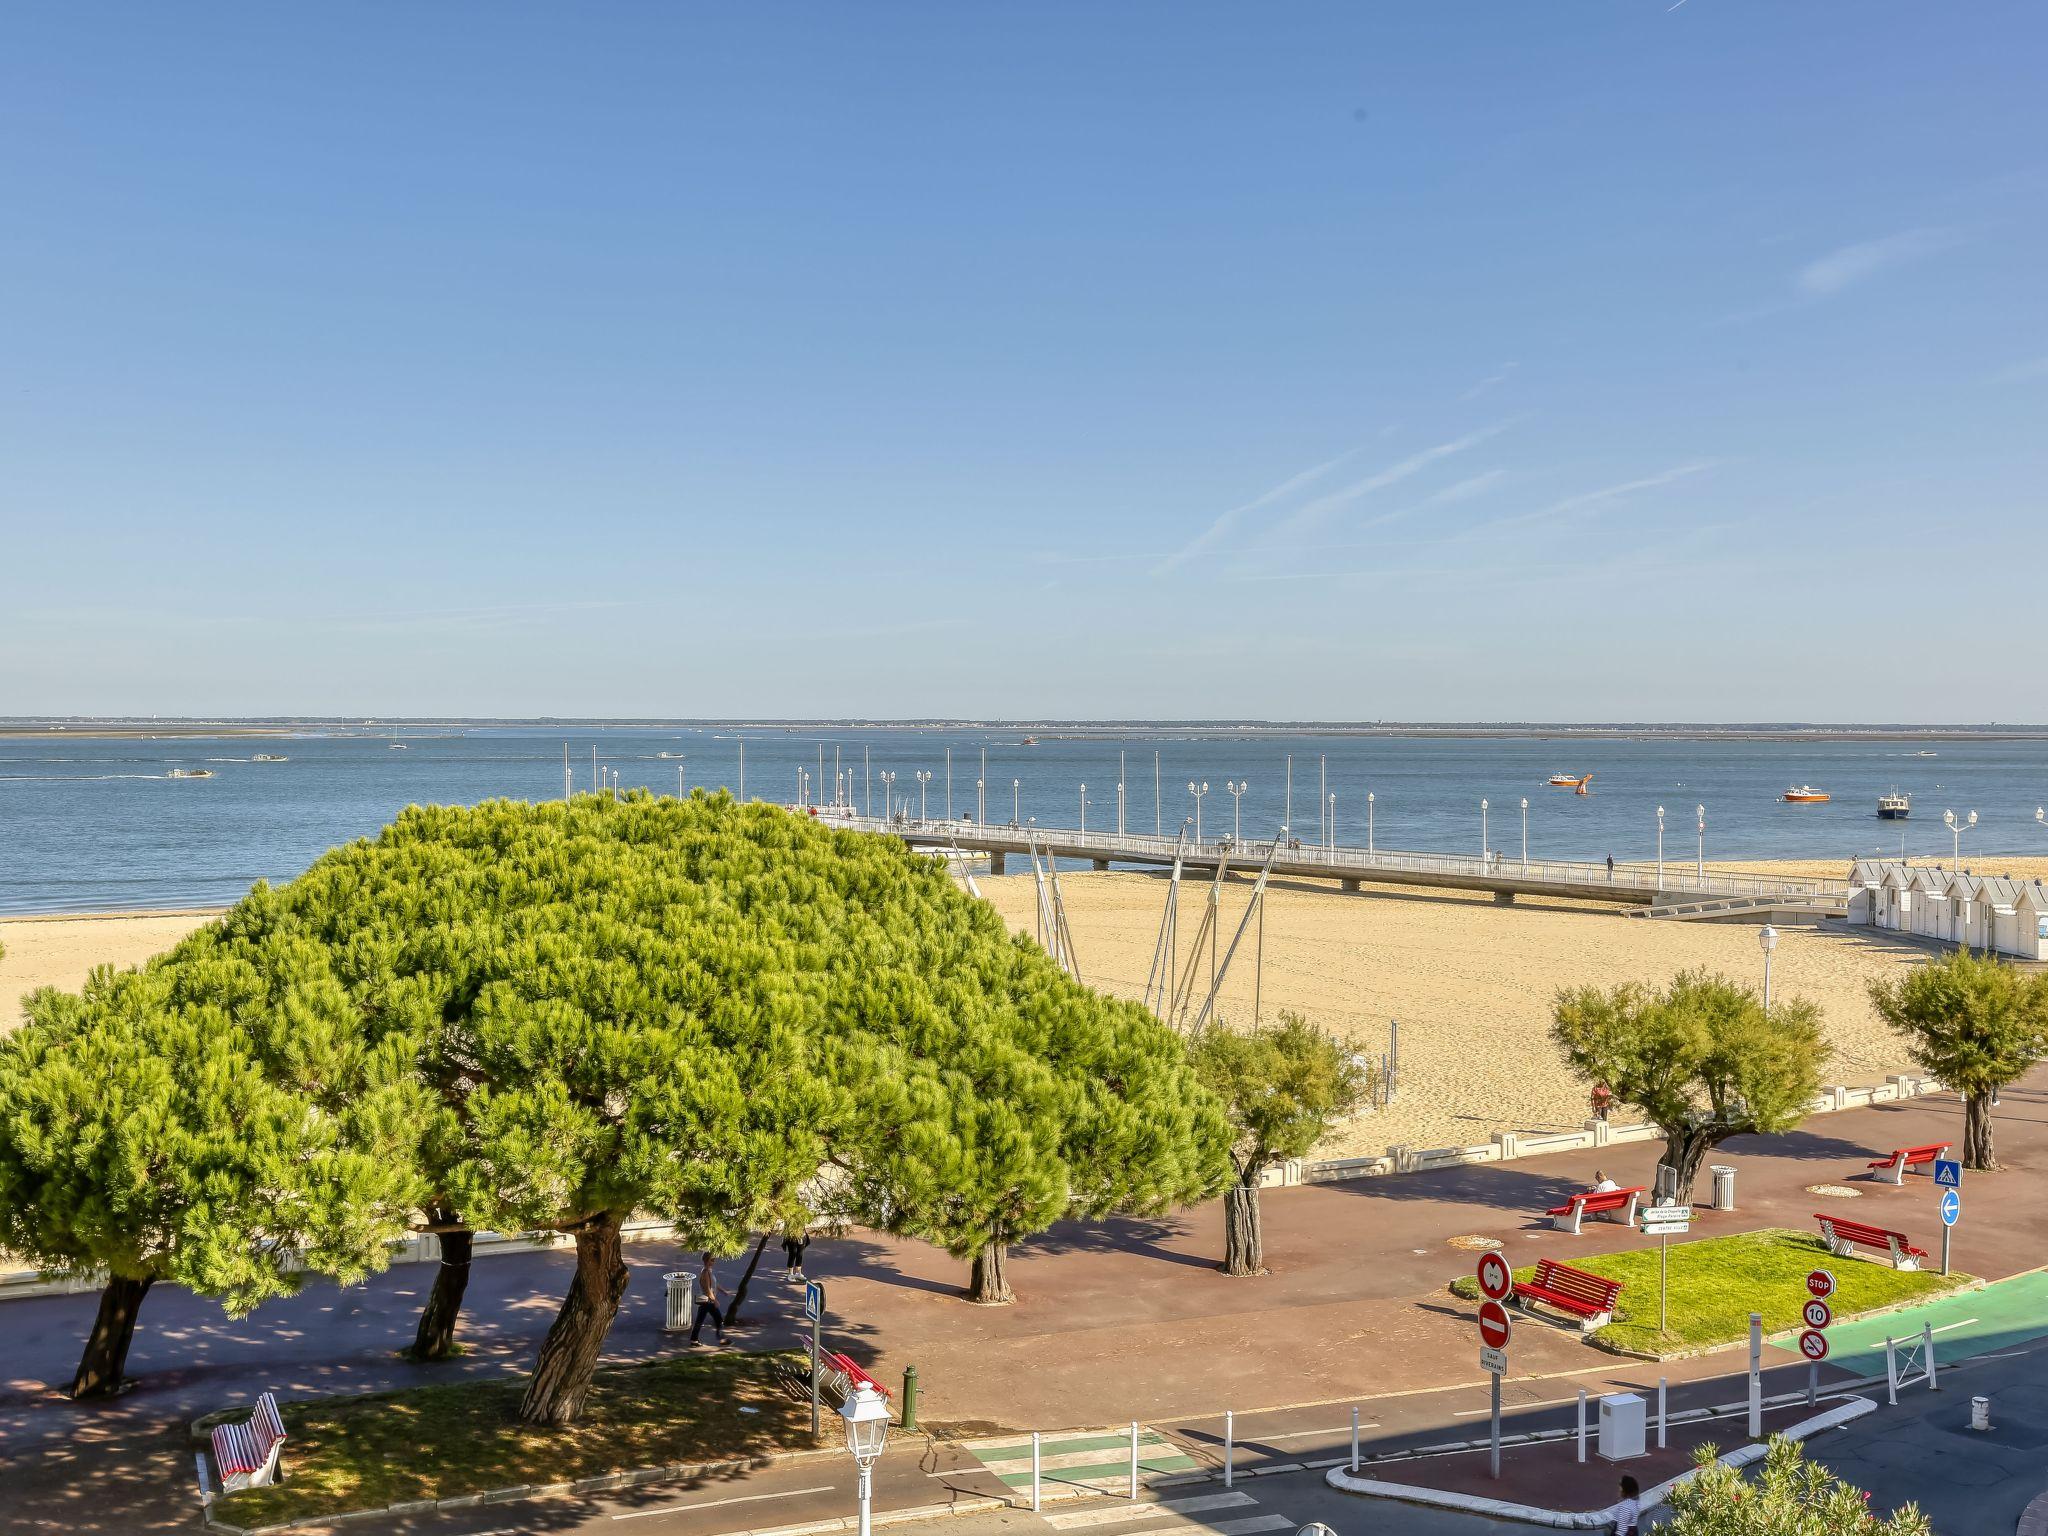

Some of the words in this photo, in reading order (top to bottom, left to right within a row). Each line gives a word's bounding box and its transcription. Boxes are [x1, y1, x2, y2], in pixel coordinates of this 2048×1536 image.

[1809, 1279, 1829, 1290] STOP
[1809, 1308, 1823, 1321] 10
[1487, 1352, 1499, 1360] SAUF
[1481, 1359, 1505, 1371] RIVERAINS
